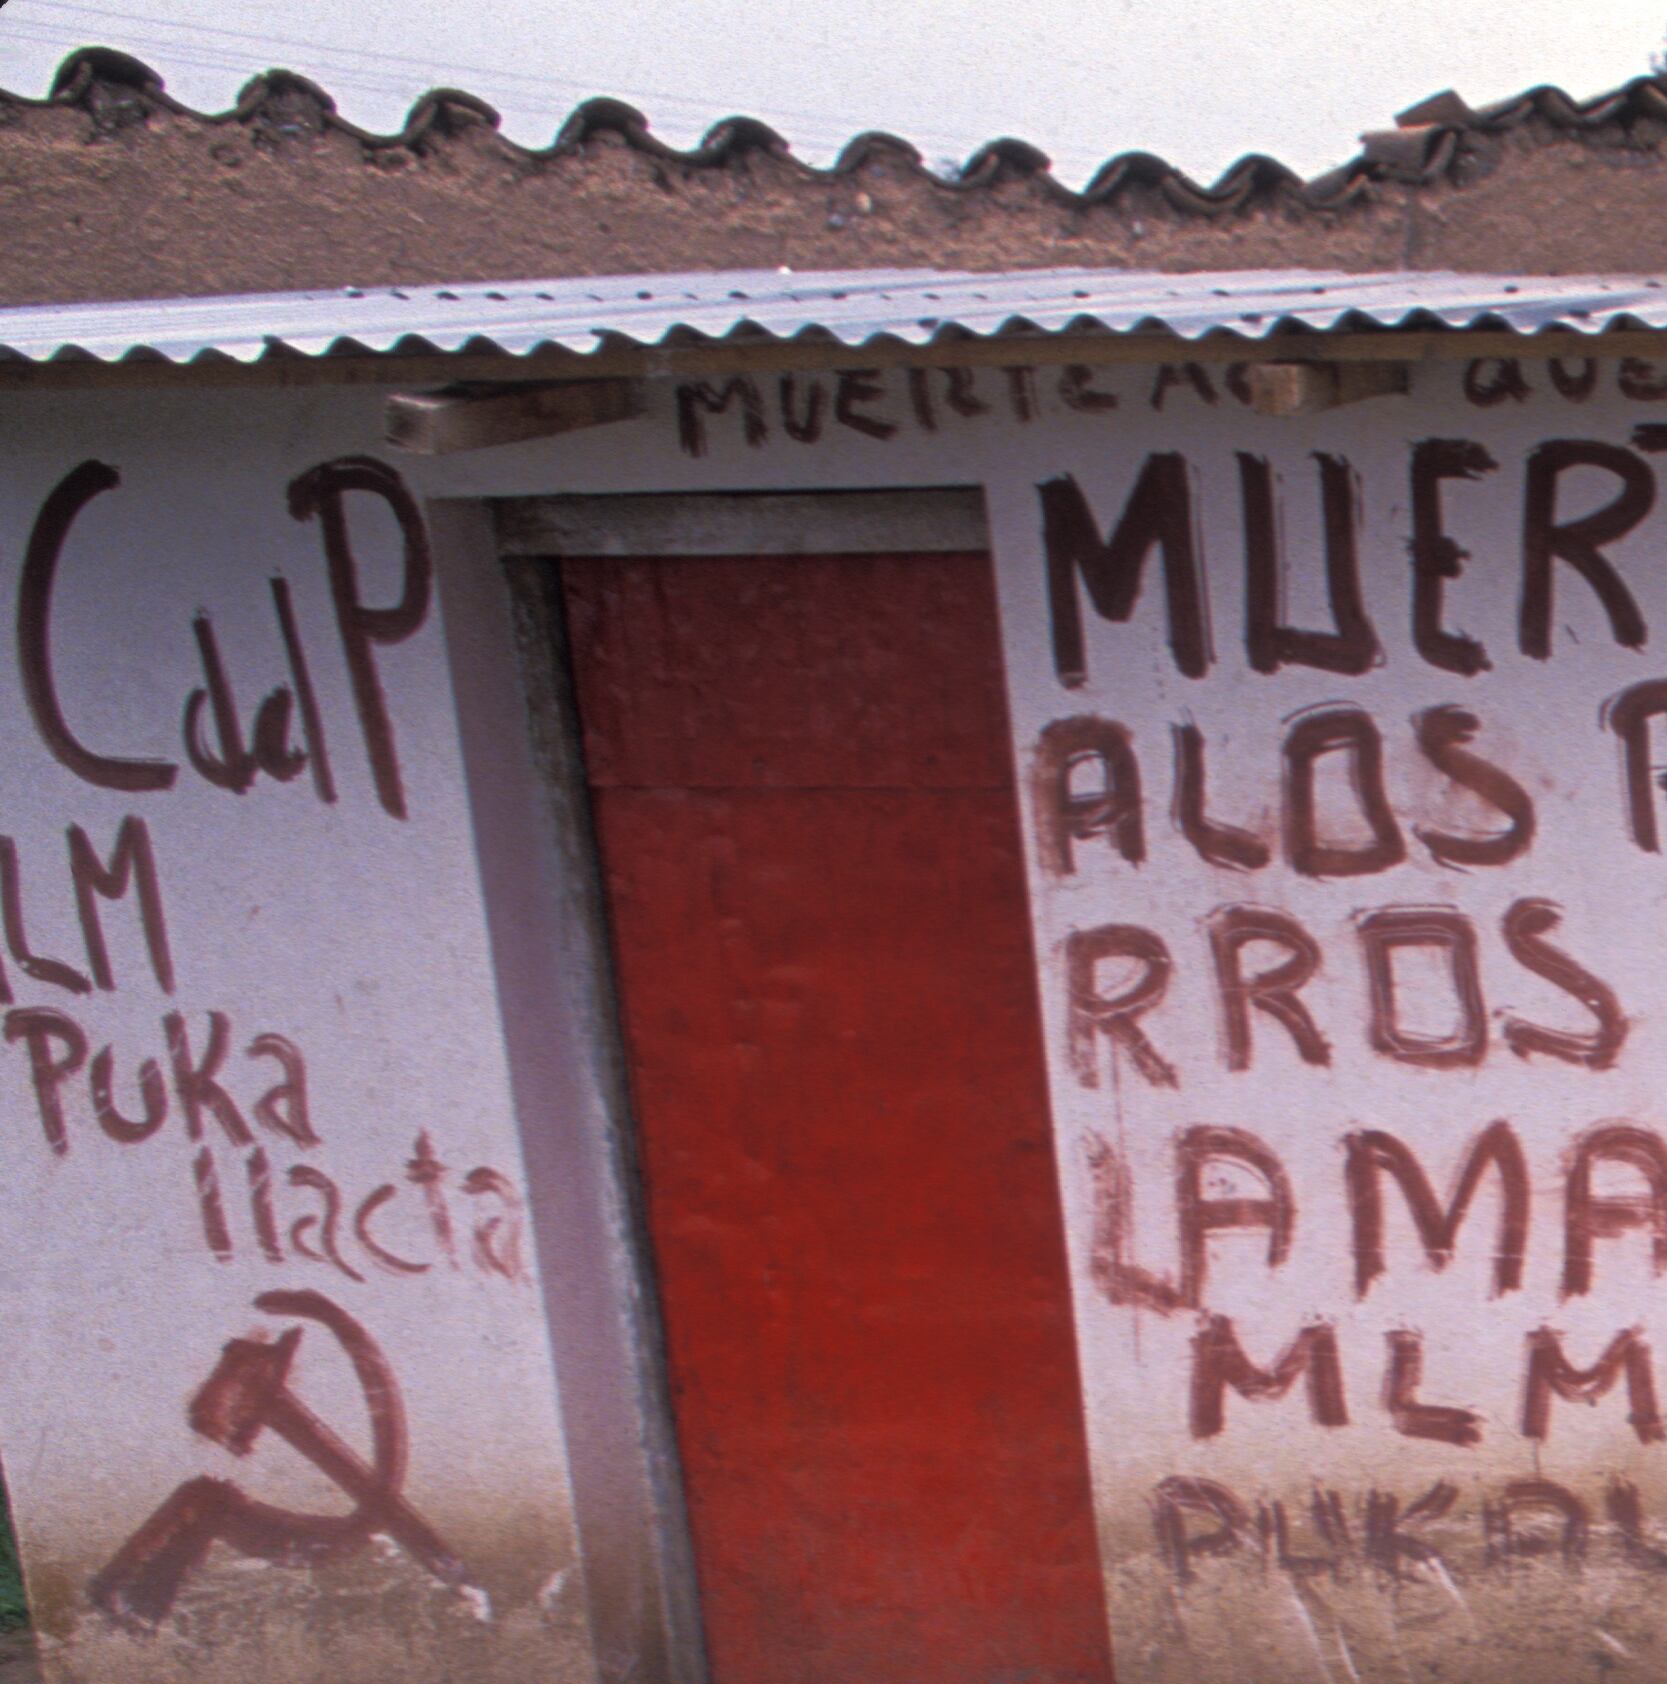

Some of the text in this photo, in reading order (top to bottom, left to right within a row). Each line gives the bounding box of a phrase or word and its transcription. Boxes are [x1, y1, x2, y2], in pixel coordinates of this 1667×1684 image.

[676, 364, 1118, 458] MUERTE
[0, 813, 175, 1004] LM
[1062, 896, 1630, 1090] RROS
